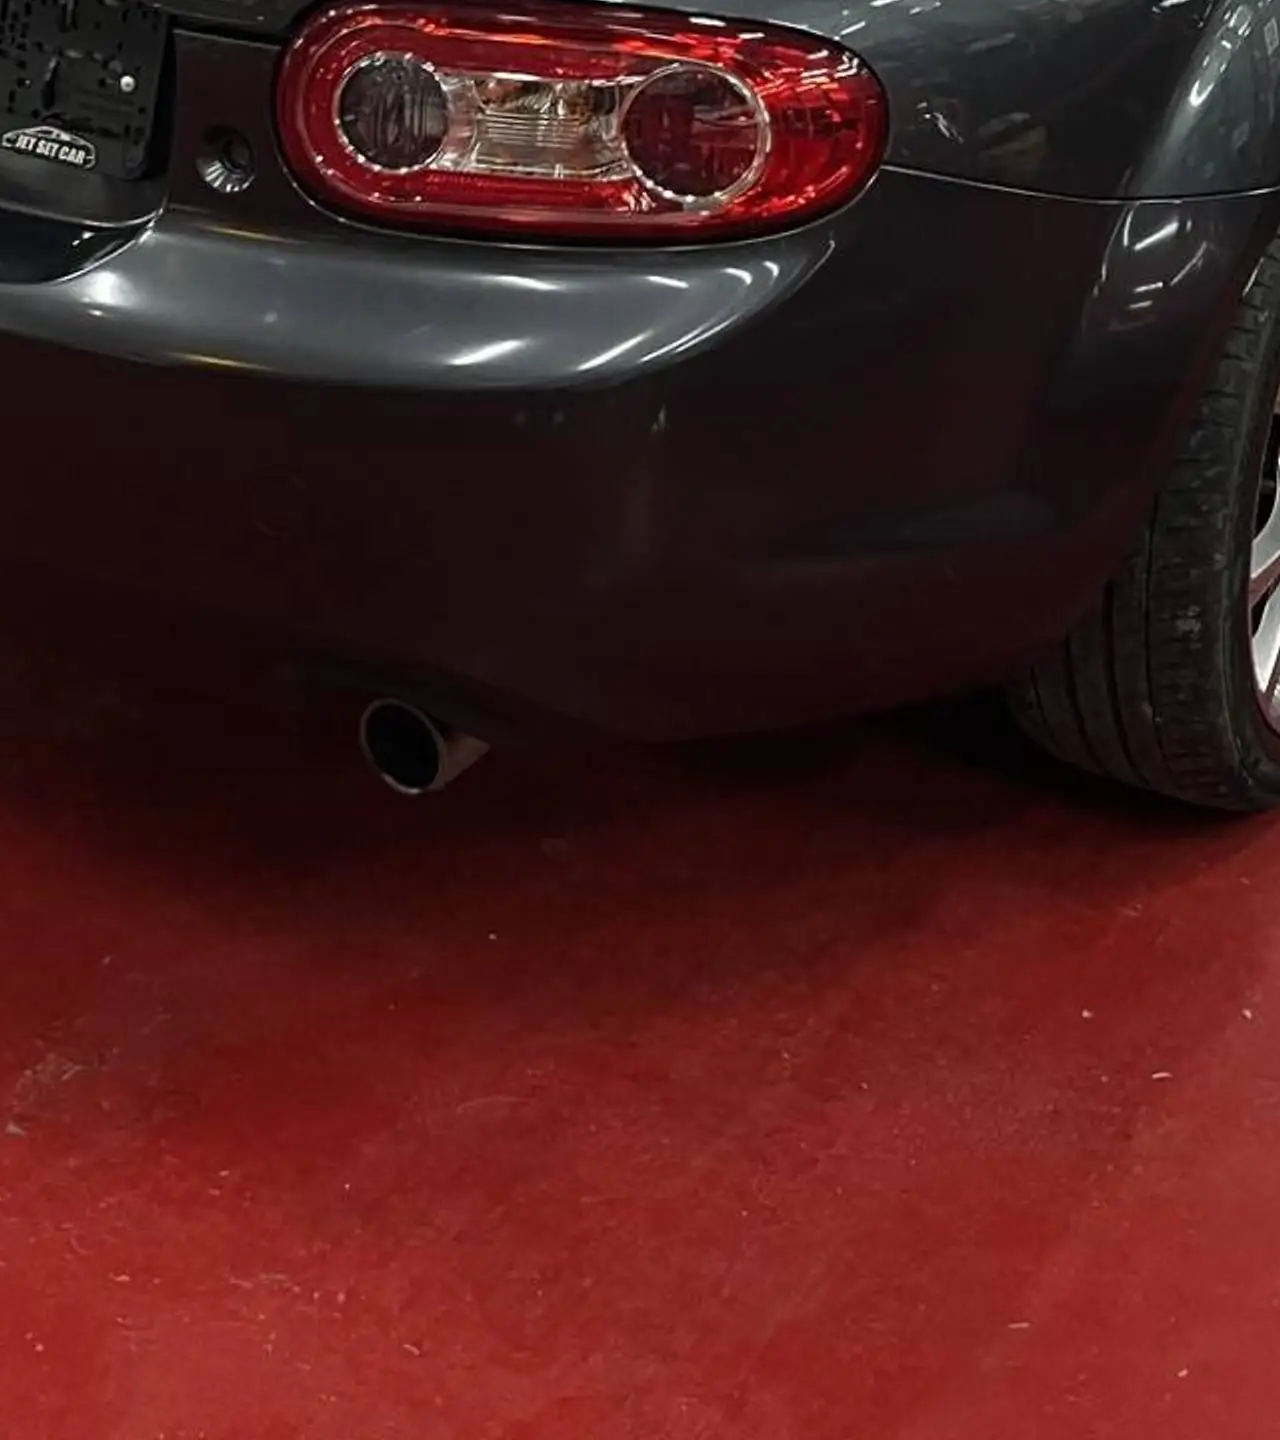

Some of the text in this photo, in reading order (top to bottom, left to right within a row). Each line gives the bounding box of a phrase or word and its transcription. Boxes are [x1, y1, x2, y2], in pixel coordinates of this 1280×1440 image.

[15, 134, 86, 165] JET SET CAR
